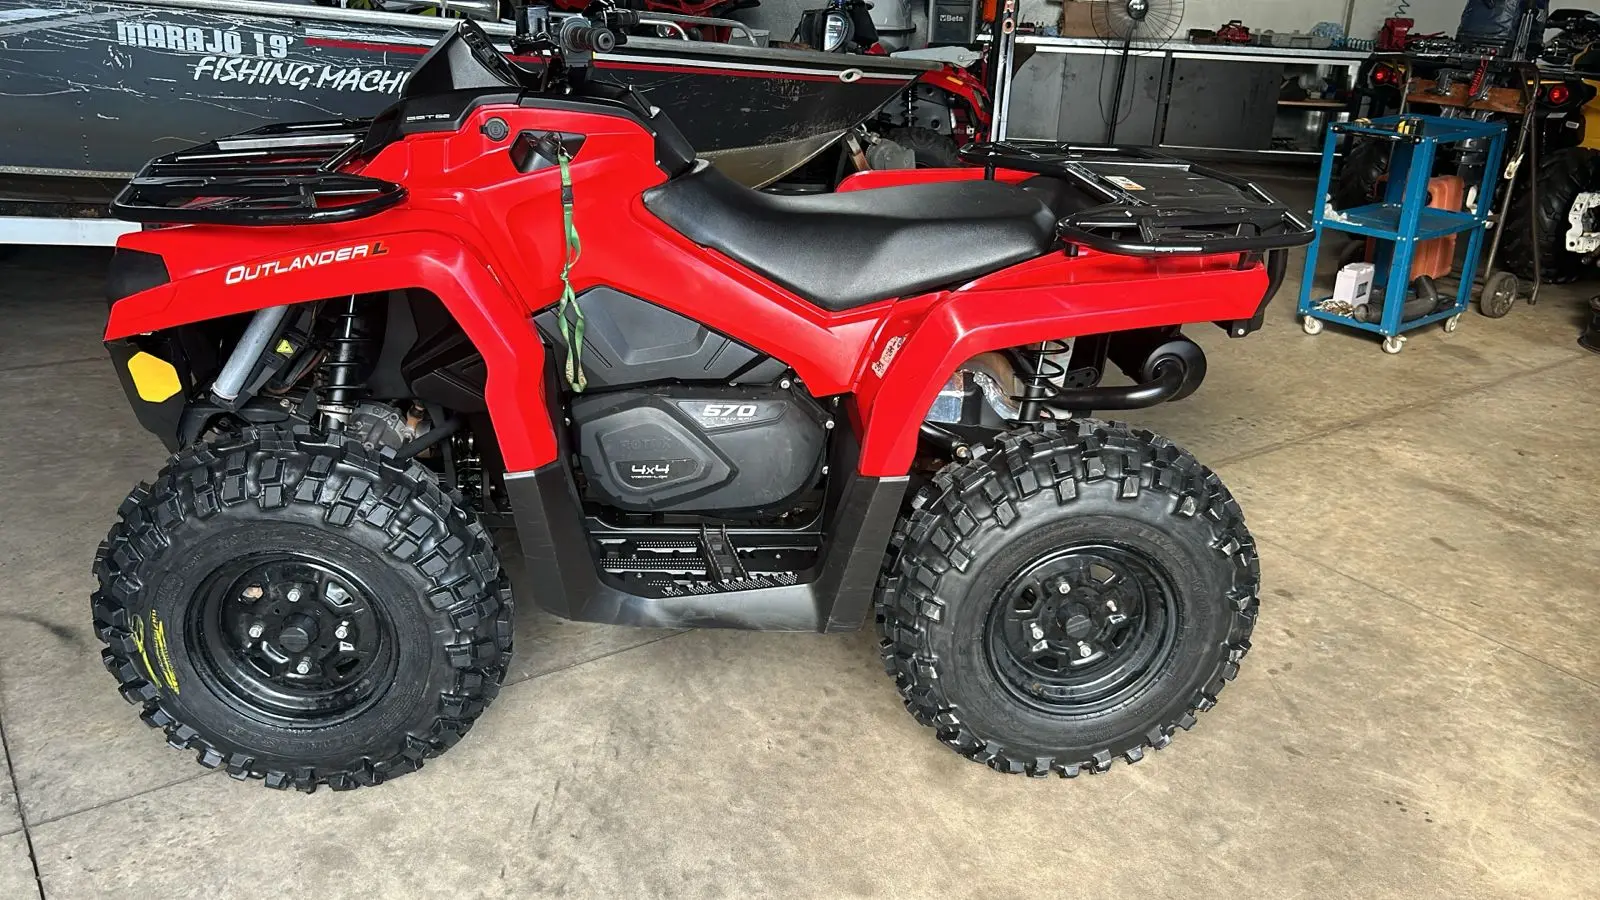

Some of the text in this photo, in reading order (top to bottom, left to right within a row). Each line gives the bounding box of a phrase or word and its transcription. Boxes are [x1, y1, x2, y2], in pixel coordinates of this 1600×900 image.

[116, 22, 242, 53] MARAJÓ
[193, 57, 315, 91] FISHING
[225, 242, 389, 285] OUTLANDER L
[702, 404, 757, 417] 570
[631, 464, 670, 475] 4x4
